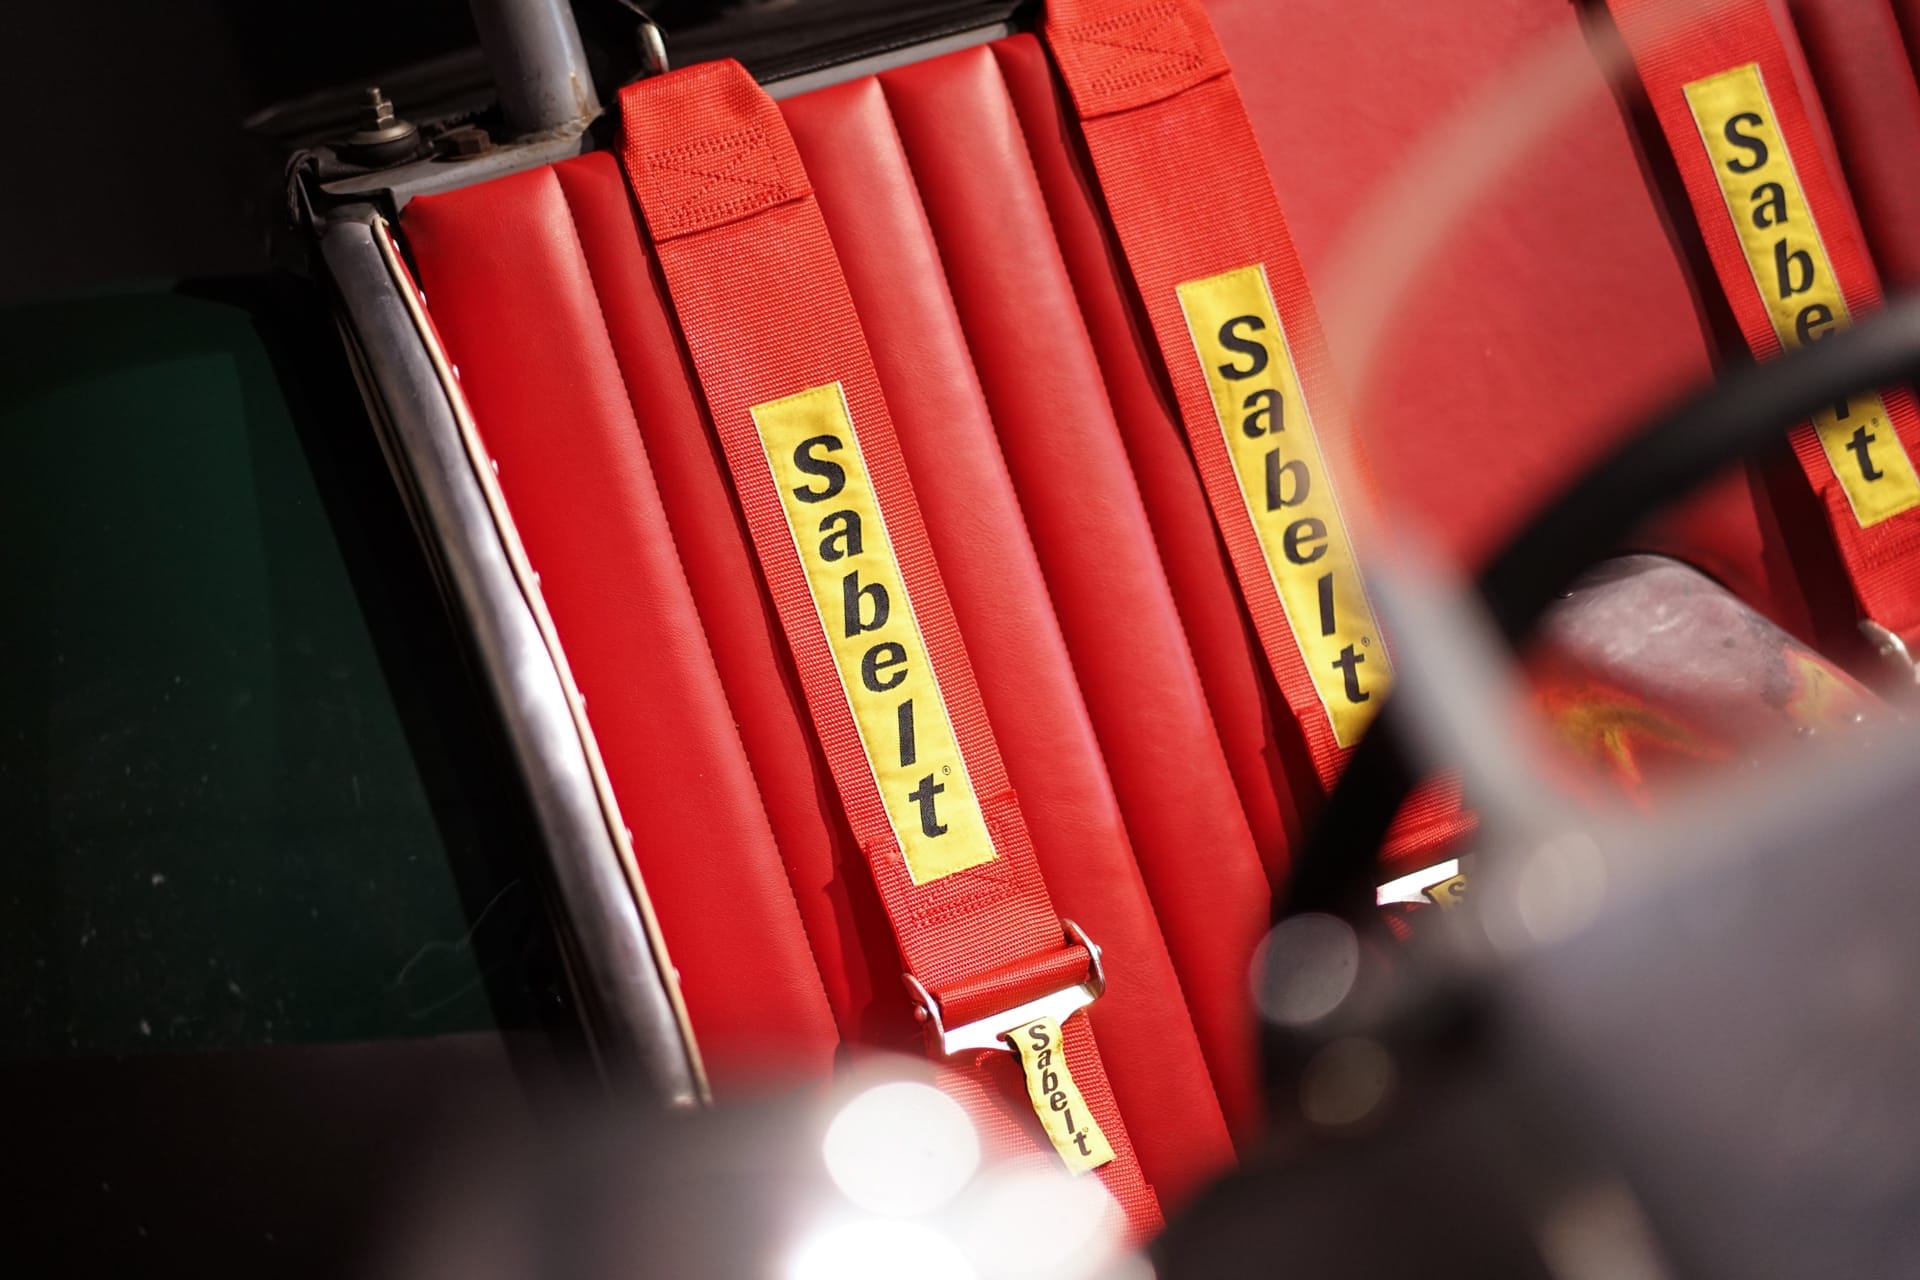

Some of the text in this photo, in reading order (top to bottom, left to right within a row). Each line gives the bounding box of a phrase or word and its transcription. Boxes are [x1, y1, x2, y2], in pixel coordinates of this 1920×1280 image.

[792, 434, 949, 838] Sabelt
[1217, 314, 1370, 704] Sabelt
[1028, 1024, 1092, 1156] Sabelt
